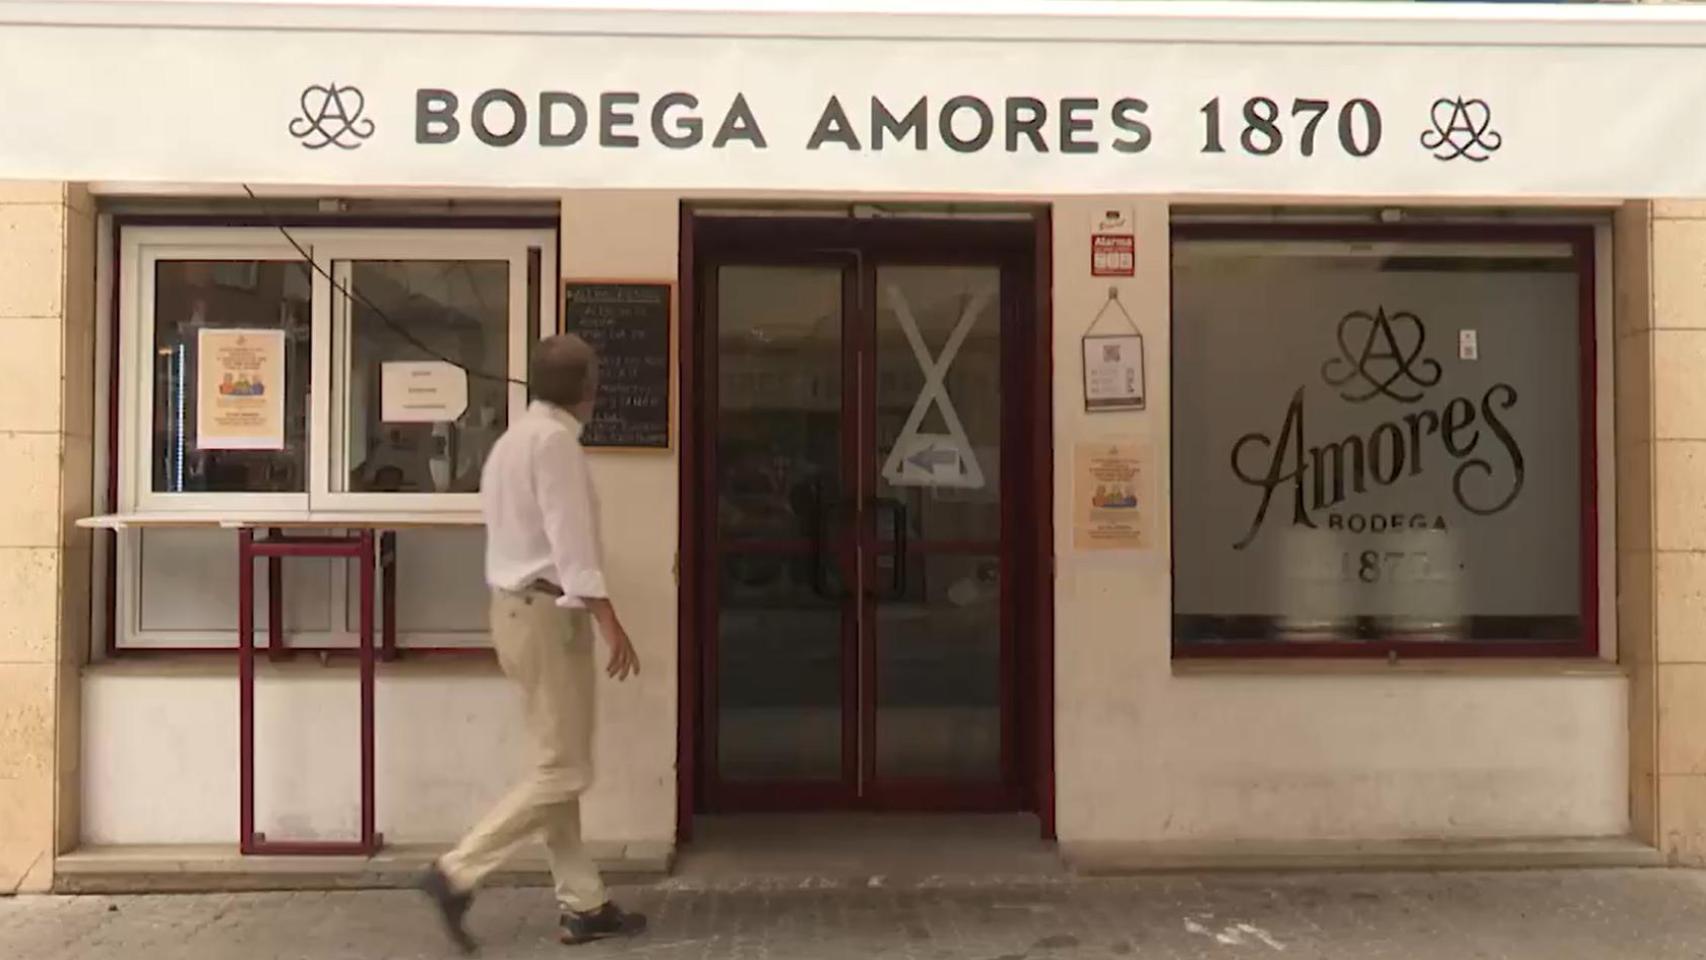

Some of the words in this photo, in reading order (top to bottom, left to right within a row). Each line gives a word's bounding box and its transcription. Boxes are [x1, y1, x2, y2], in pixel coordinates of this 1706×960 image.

[416, 88, 767, 149] BODEGA
[806, 95, 1152, 153] AMORES
[1200, 96, 1382, 157] 1870
[1230, 382, 1526, 549] Amores
